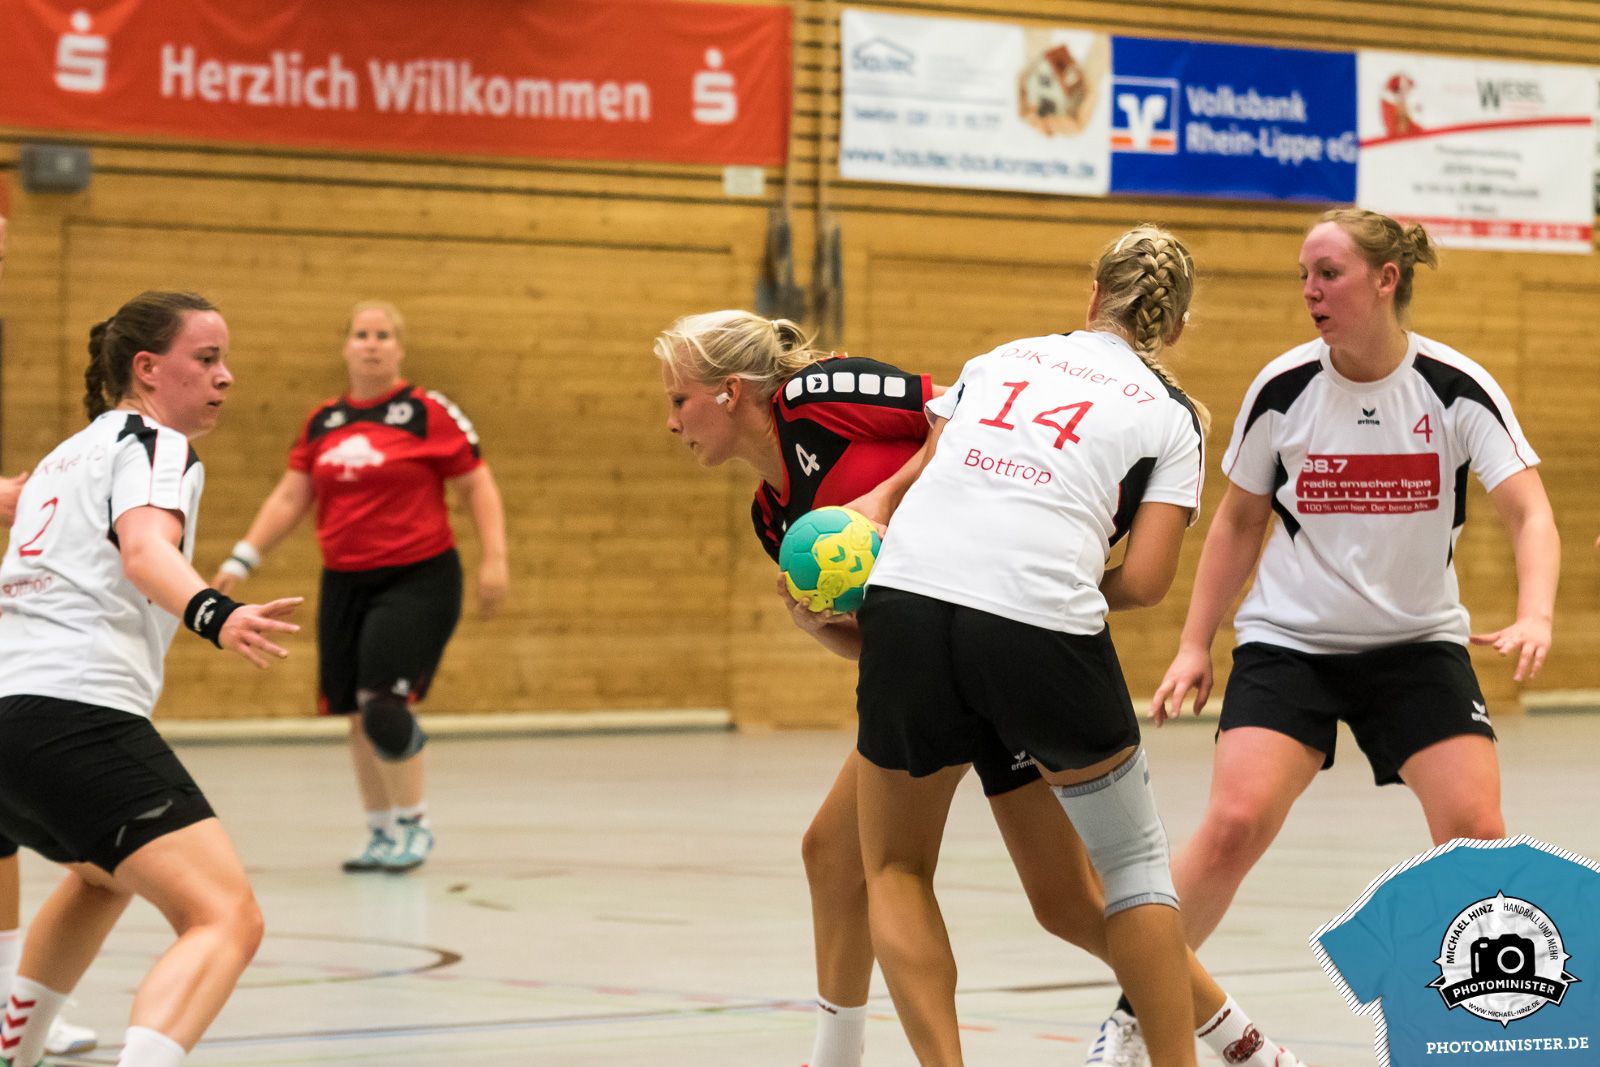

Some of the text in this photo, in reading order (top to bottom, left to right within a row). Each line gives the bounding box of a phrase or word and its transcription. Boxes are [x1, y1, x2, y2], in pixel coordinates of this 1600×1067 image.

[160, 43, 651, 121] Herzlich Willkommen
[1186, 84, 1307, 123] Volksbank
[1186, 121, 1358, 165] Rhein-Lippe eG
[1001, 346, 1156, 406] DJK Adler 07
[978, 379, 1095, 451] 14
[1412, 413, 1433, 444] 4
[795, 442, 821, 477] 4
[963, 448, 1053, 486] Bottrop
[1302, 459, 1348, 474] 98.7
[1302, 478, 1432, 490] radio emscher lippe
[1370, 503, 1386, 512] Der
[1388, 503, 1412, 512] beste
[18, 497, 59, 557] 2
[1011, 759, 1036, 771] erima
